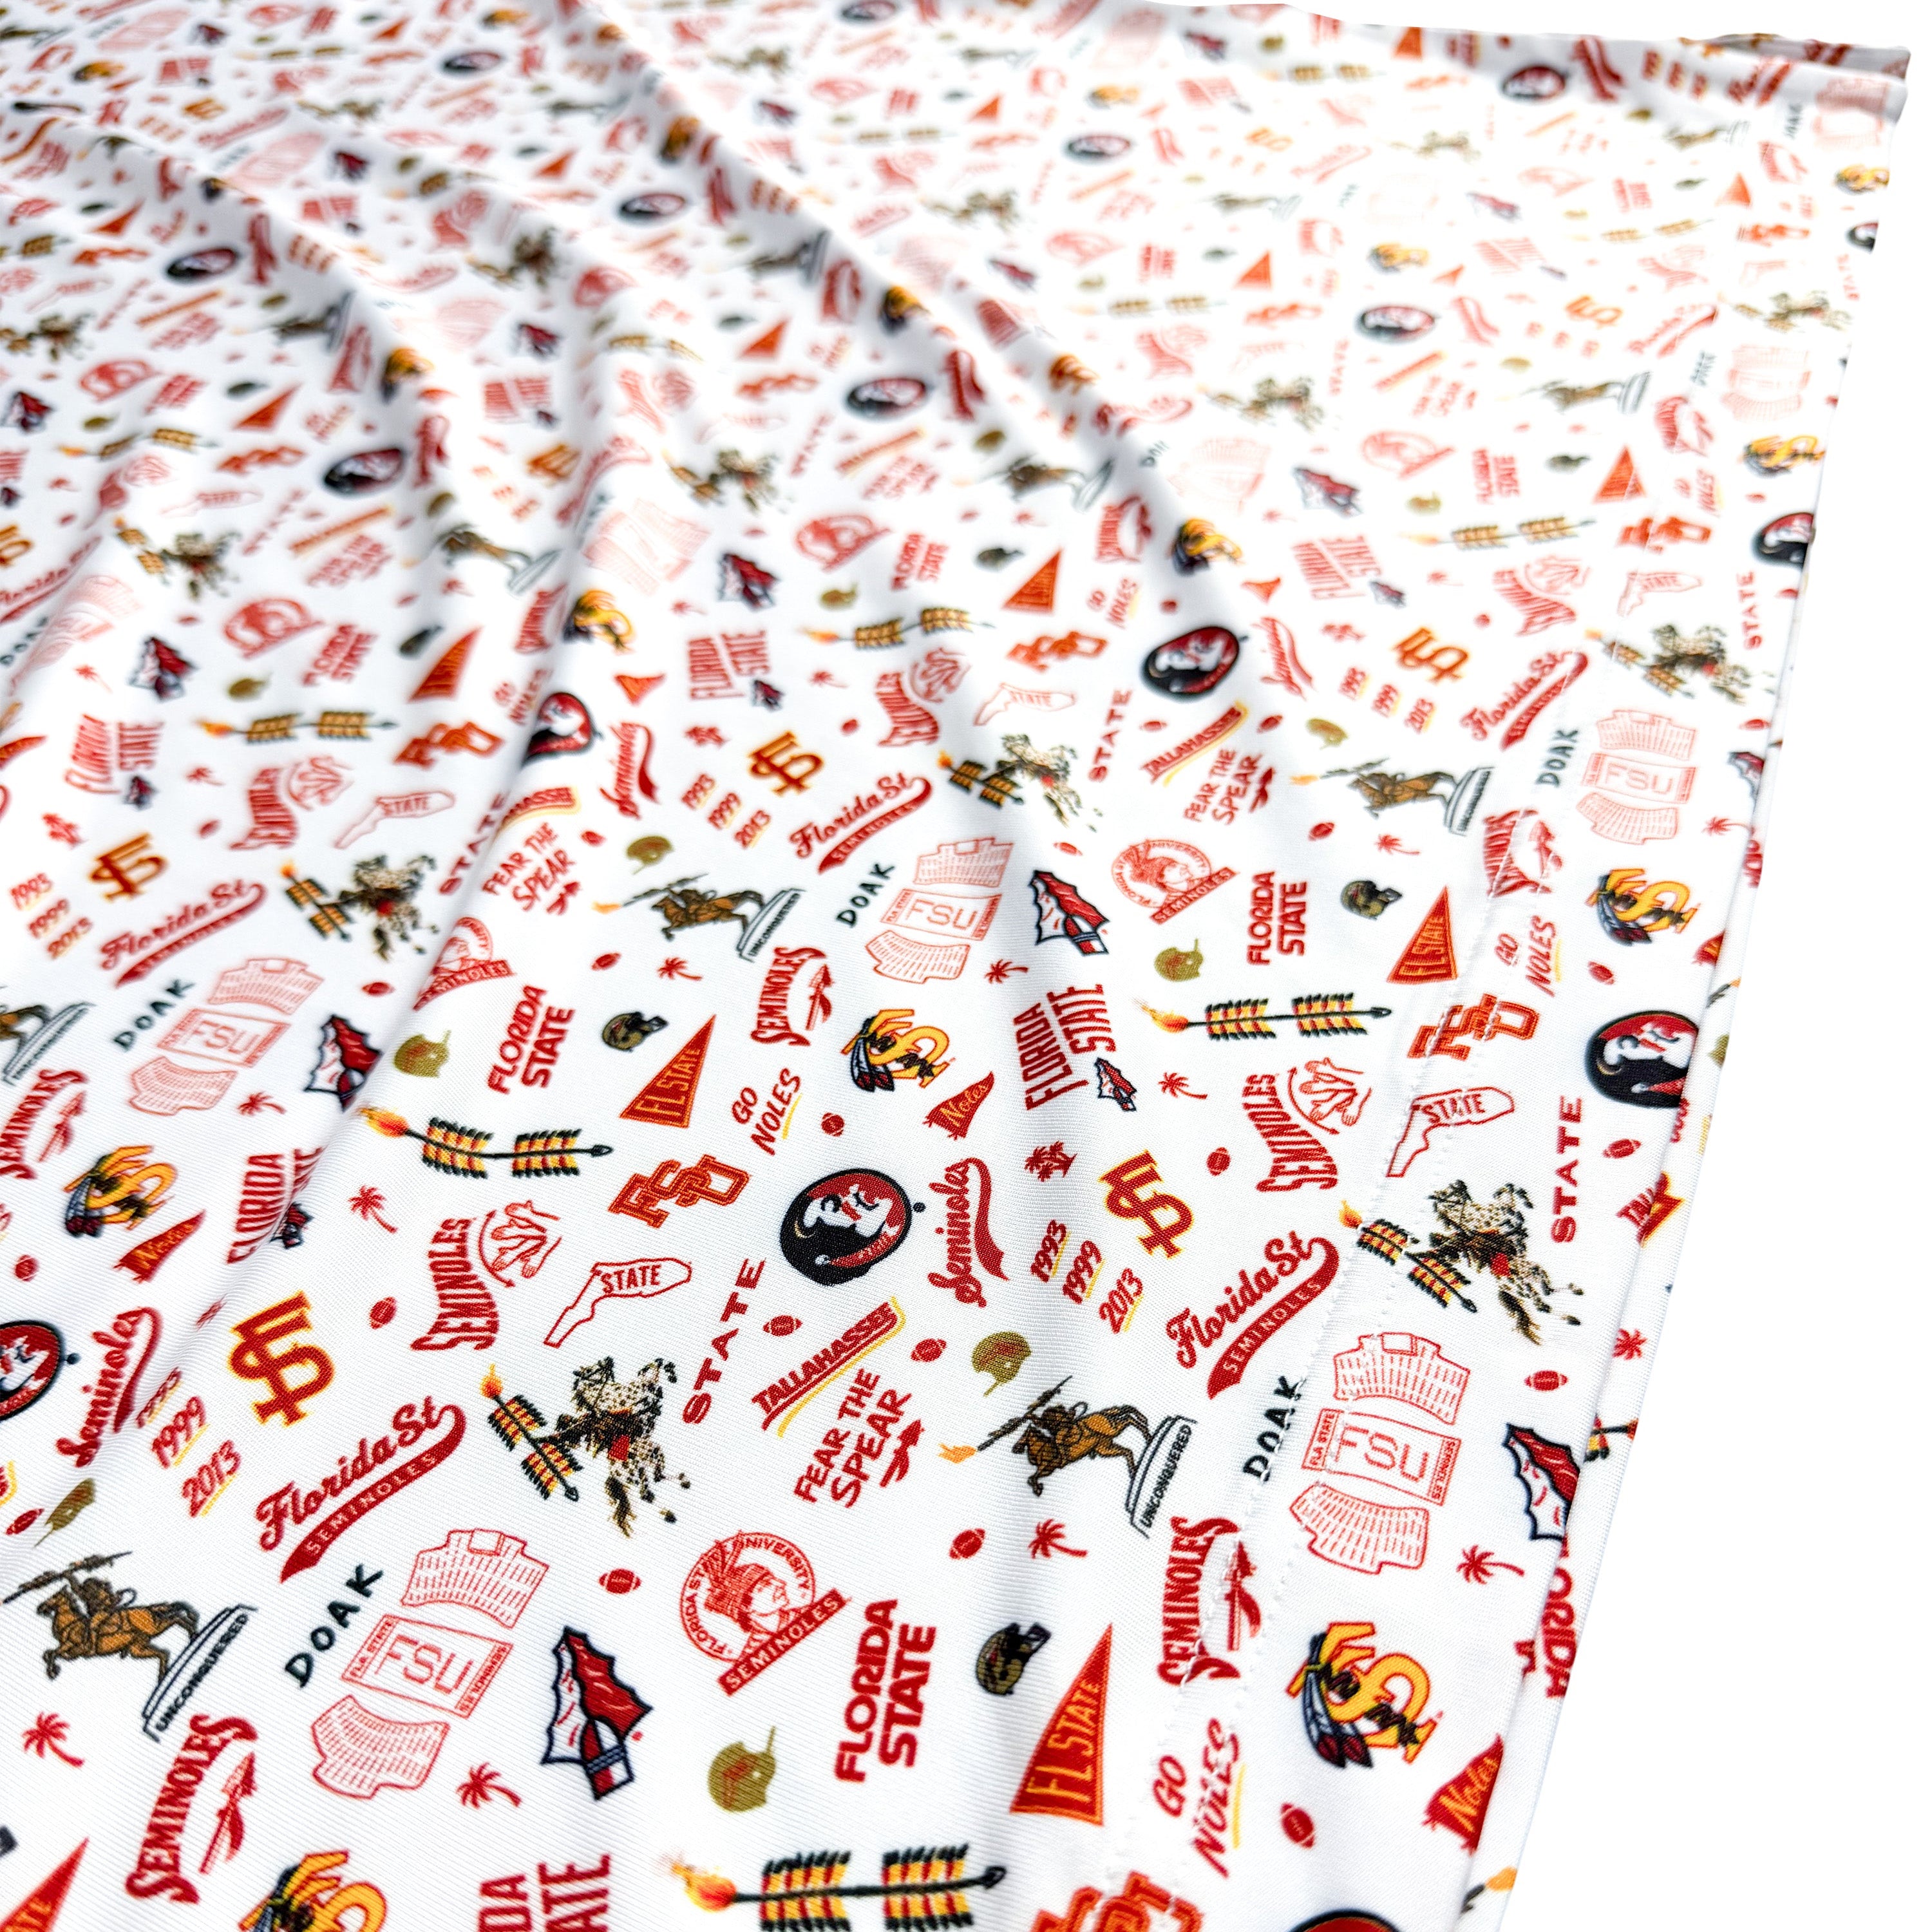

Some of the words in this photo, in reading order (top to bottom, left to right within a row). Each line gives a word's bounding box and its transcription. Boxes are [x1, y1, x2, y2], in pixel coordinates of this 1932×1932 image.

[1736, 571, 1763, 649] STATE
[1089, 689, 1133, 781] STATE
[1535, 728, 1579, 787] DOAK
[790, 794, 882, 858] Florida
[877, 773, 912, 800] St
[1184, 782, 1220, 821] FEAR
[1210, 749, 1236, 781] THE
[1213, 753, 1262, 825] SPEAR
[1606, 762, 1672, 795] FSU
[482, 853, 530, 895] FEAR
[524, 823, 557, 852] THE
[735, 810, 771, 848] 2013
[513, 849, 575, 911] SPEAR
[836, 863, 896, 928] DOAK
[905, 898, 977, 930] FSU
[1153, 869, 1231, 922] SEMINOLES
[1247, 871, 1275, 965] FLORIDA
[1277, 881, 1307, 956] STATE
[100, 903, 209, 970] Florida
[1495, 933, 1520, 966] GO
[1526, 915, 1557, 997] NOLES
[113, 980, 195, 1051] DOAK
[750, 946, 826, 1046] SEMINOLES
[1046, 984, 1116, 1054] STATE
[187, 1021, 260, 1054] FSU
[488, 985, 547, 1094] FLORIDA
[521, 1006, 575, 1088] STATE
[659, 1046, 702, 1094] STATE
[1014, 1002, 1089, 1111] FLORIDA
[732, 1087, 758, 1124] GO
[750, 1068, 801, 1156] NOLES
[940, 1083, 988, 1127] Noles
[1242, 1074, 1338, 1192] SEMINOLES
[1551, 1095, 1582, 1243] STATE
[928, 1158, 992, 1308] Seminoles
[1032, 1219, 1066, 1282] 1993
[1063, 1240, 1103, 1305] 1999
[410, 1218, 499, 1350] SEMINOLES
[600, 1265, 661, 1293] STATE
[1099, 1267, 1144, 1334] 2013
[1166, 1269, 1278, 1368] Florida
[1264, 1231, 1312, 1278] St
[683, 1258, 766, 1424] STATE
[752, 1302, 896, 1414] TALLAHASSEE
[1222, 1281, 1322, 1374] SEMINOLES
[55, 1307, 151, 1467] Seminoles
[151, 1396, 207, 1468] 1999
[794, 1428, 851, 1502] FEAR
[838, 1368, 880, 1419] THE
[831, 1388, 913, 1508] SPEAR
[1243, 1376, 1306, 1483] DOAK
[1334, 1425, 1432, 1481] FSU
[182, 1440, 241, 1517] 2013
[256, 1439, 397, 1551] Florida
[392, 1396, 442, 1446] St
[307, 1451, 438, 1555] SEMINOLES
[1139, 1424, 1192, 1528] UNCONQUERED
[285, 1564, 384, 1688] DOAK
[724, 1594, 839, 1687] SEMINOLES
[1159, 1517, 1240, 1685] SEMINOLES
[155, 1613, 249, 1733] UNCONQUERED
[375, 1633, 474, 1695] FSU
[833, 1598, 898, 1783] FLORIDA
[878, 1624, 936, 1767] STATE
[1048, 1679, 1100, 1756] STATE
[125, 1714, 259, 1904] SEMINOLES
[1025, 1741, 1093, 1803] FL
[1153, 1755, 1186, 1817] GO
[1193, 1717, 1240, 1879] NOLES
[1439, 1757, 1499, 1832] Noles
